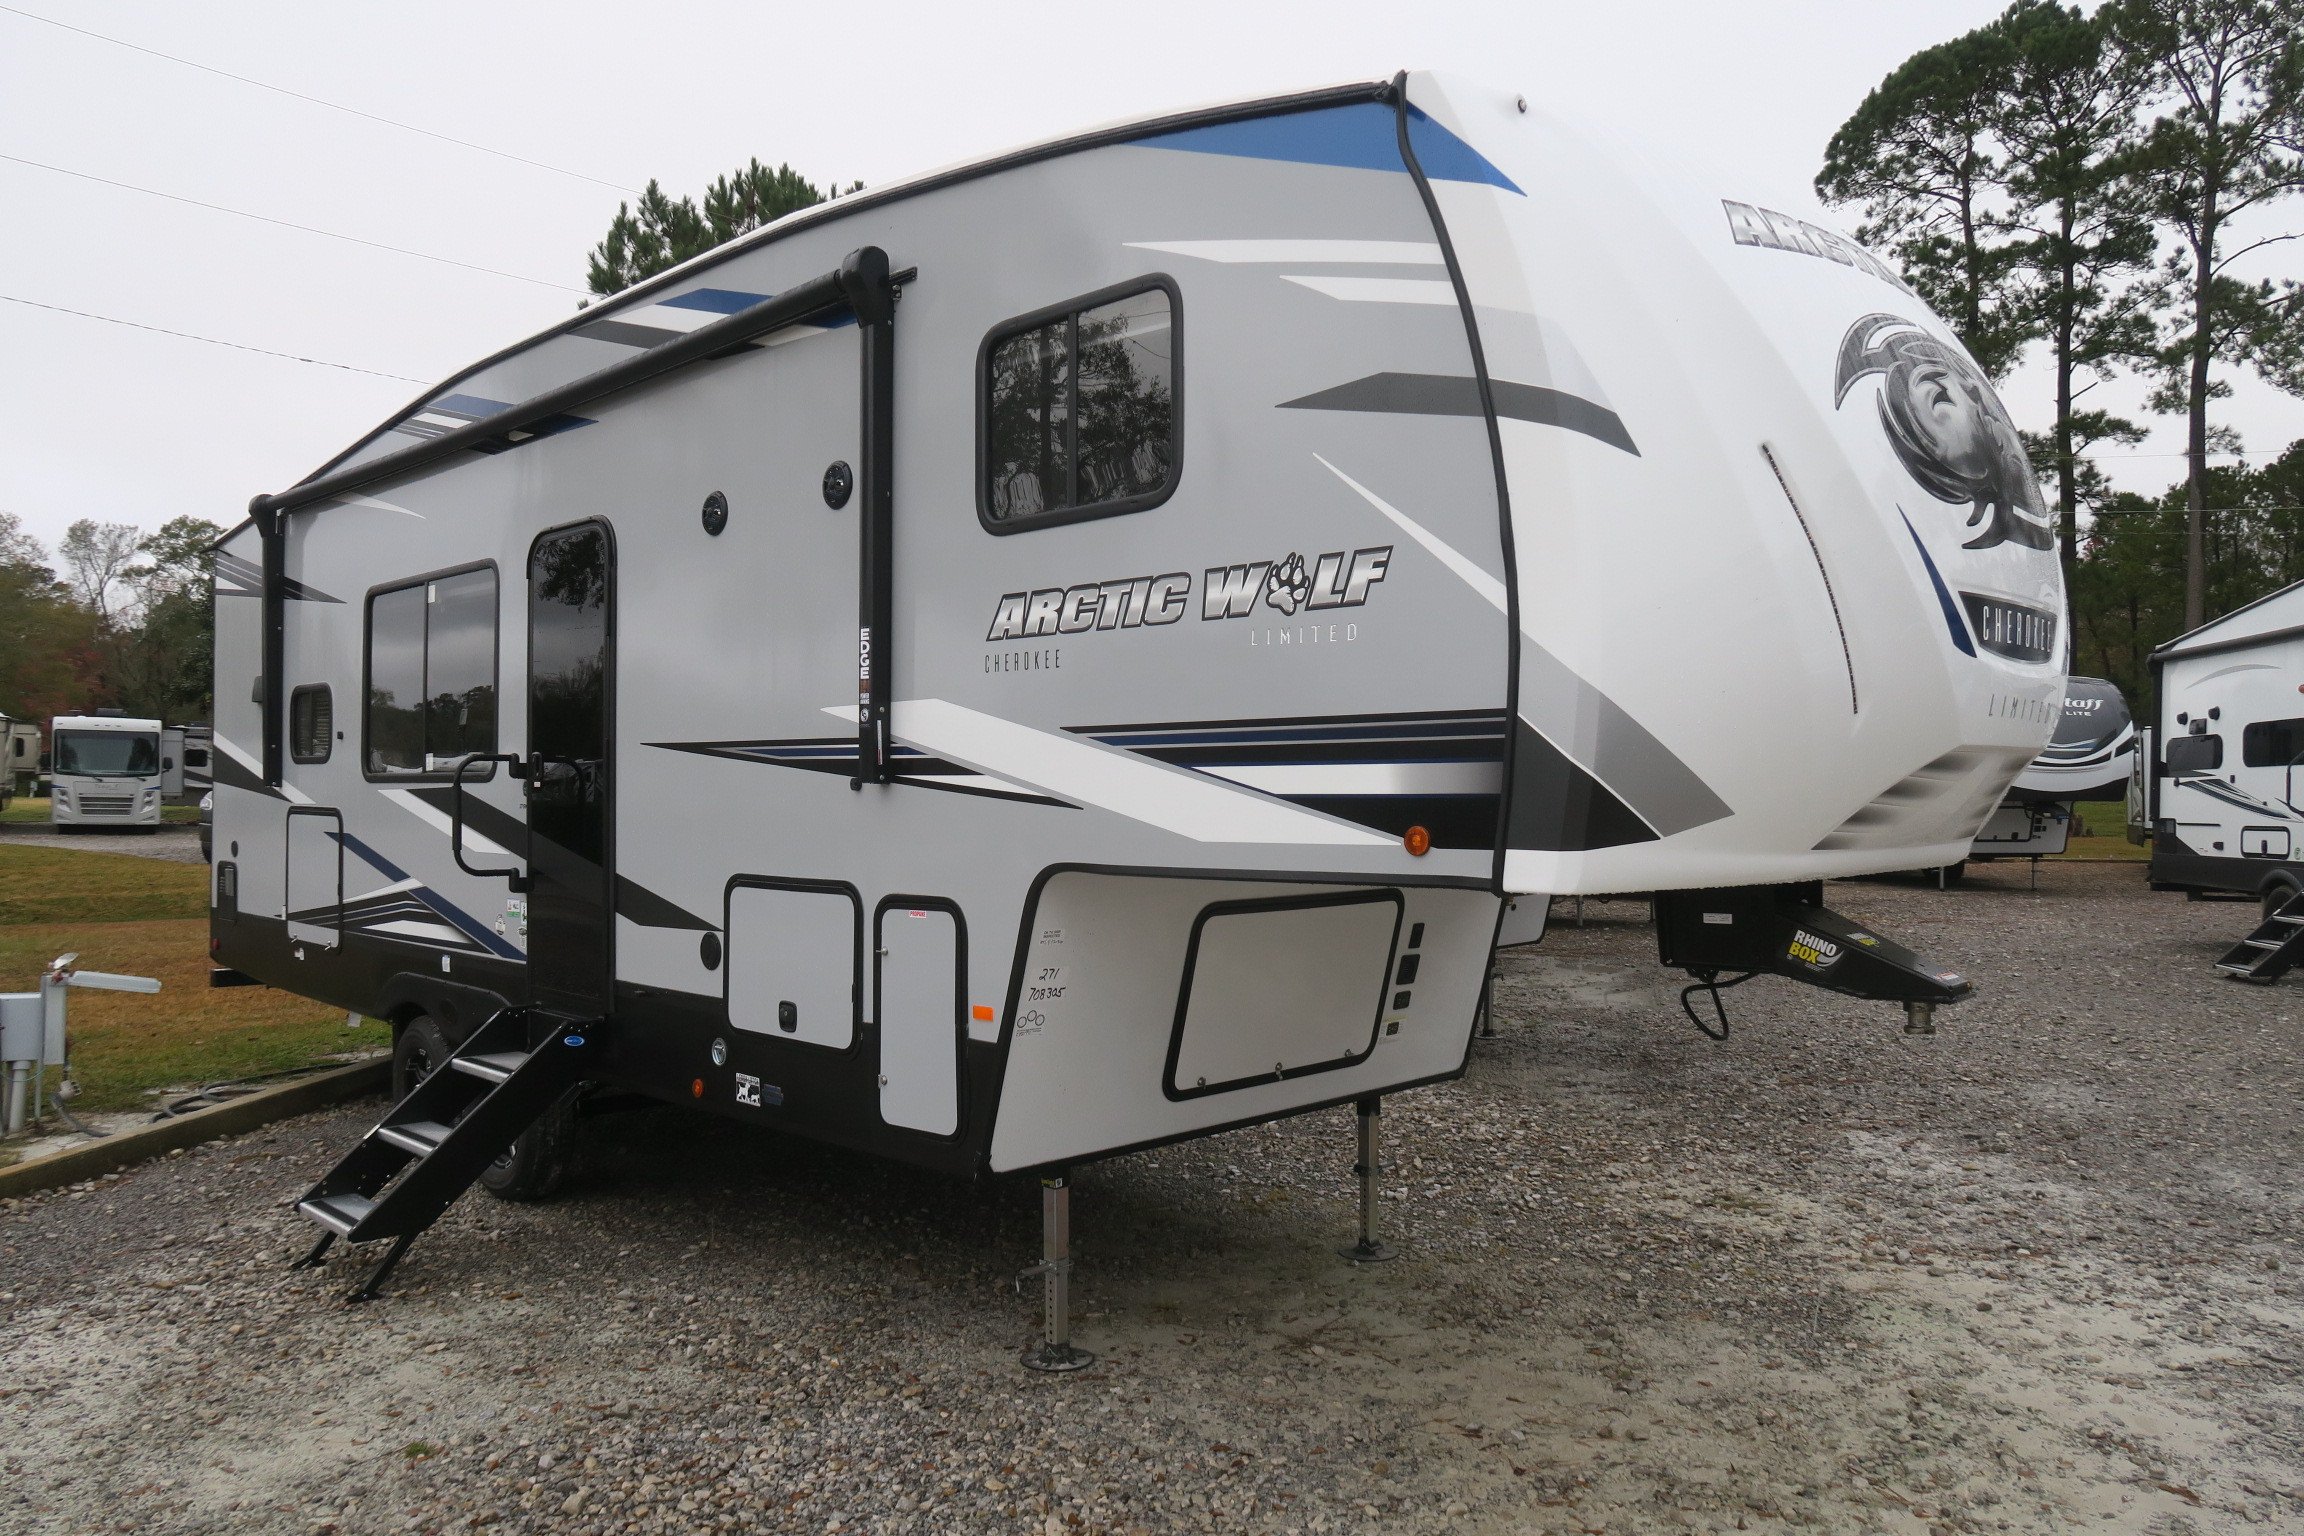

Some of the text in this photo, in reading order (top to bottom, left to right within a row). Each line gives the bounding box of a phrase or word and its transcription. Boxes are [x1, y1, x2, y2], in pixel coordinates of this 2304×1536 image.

[986, 571, 1192, 642] ARCTIC
[1250, 622, 1358, 647] LIMITED
[1983, 605, 2052, 653] CHEROKEE
[860, 628, 870, 679] EDGE
[984, 649, 1062, 674] CHEROKEE
[2064, 697, 2104, 710] taff
[1789, 941, 1820, 964] BOX
[1794, 930, 1837, 956] RHINO
[1039, 968, 1060, 981] 271
